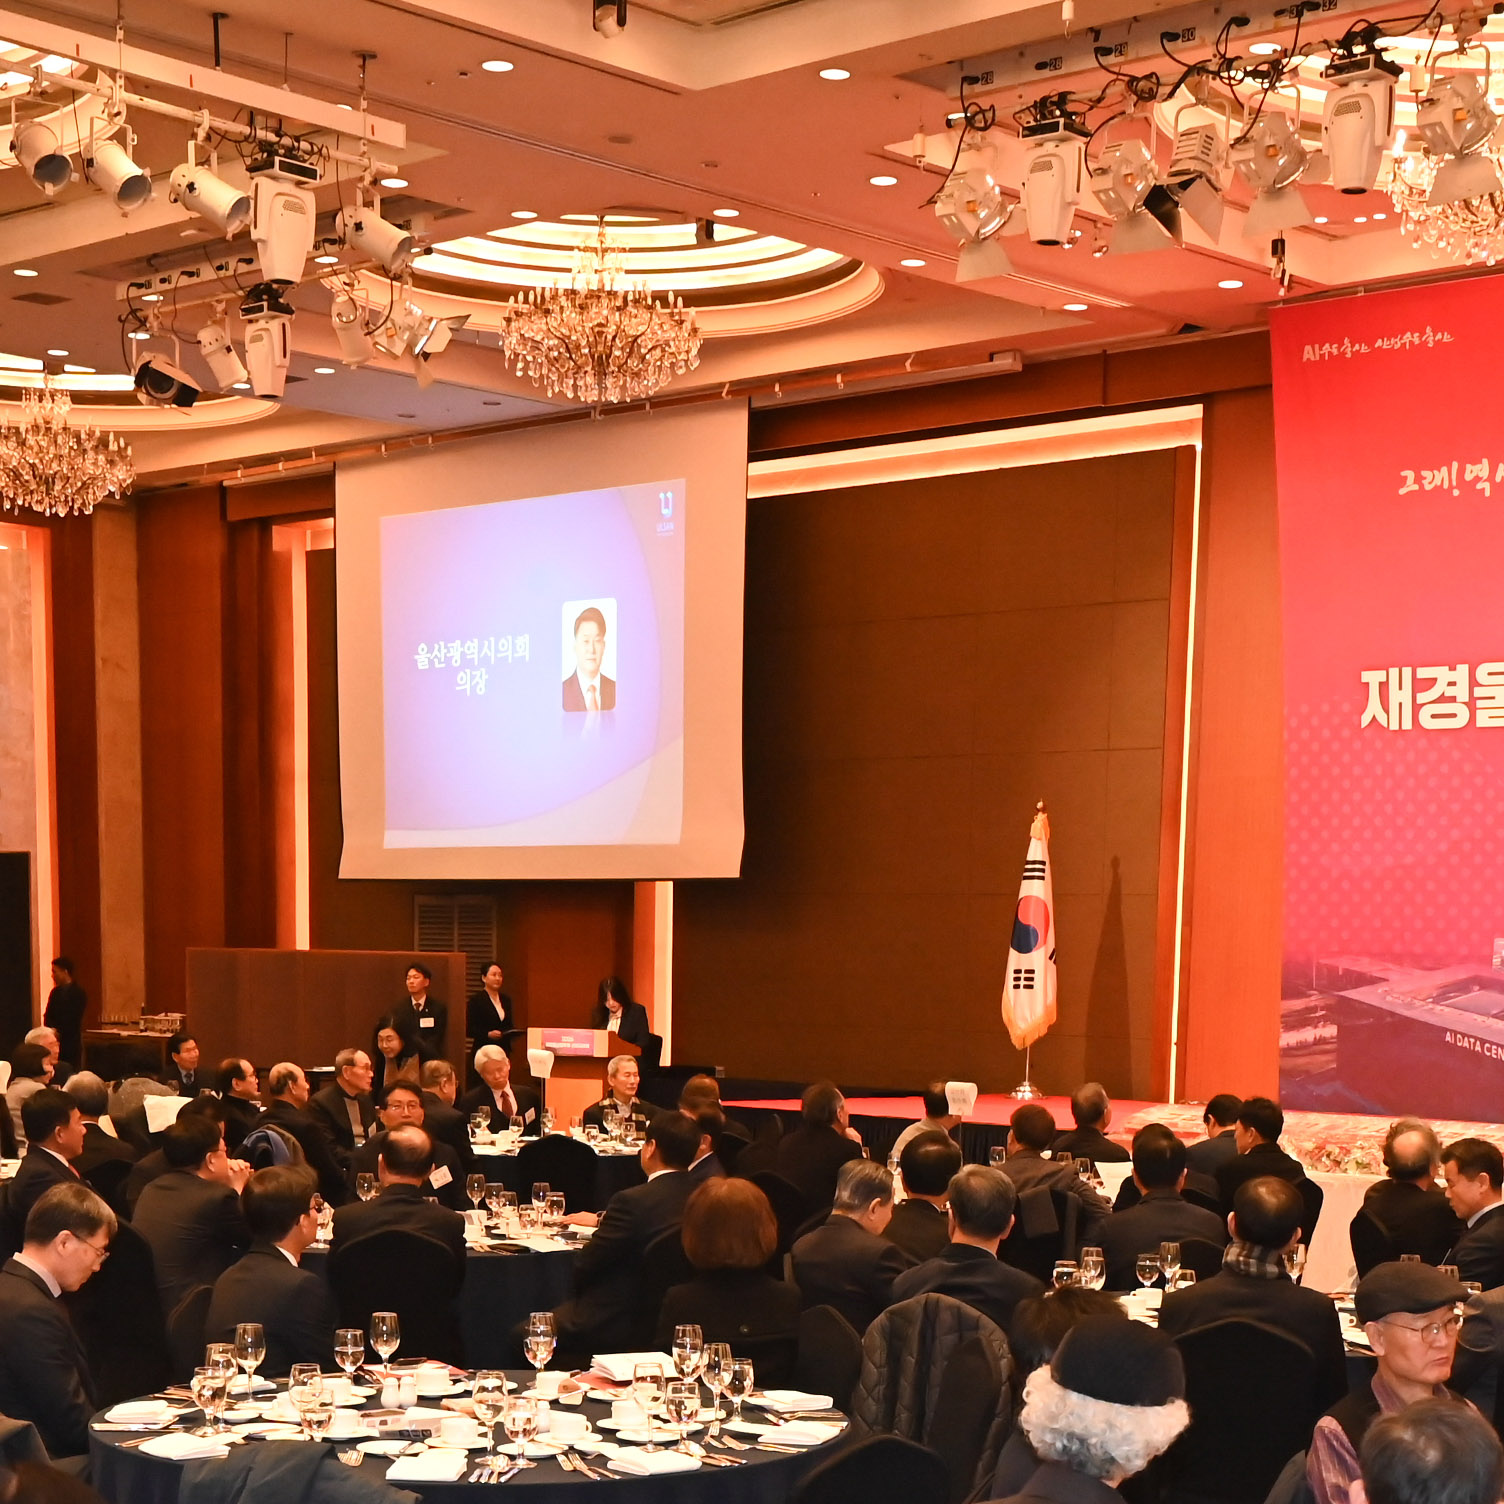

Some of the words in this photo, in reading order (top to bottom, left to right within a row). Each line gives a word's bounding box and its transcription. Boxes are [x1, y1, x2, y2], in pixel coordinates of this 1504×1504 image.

[1182, 28, 1196, 42] 30
[413, 633, 532, 671] 울산광역시의회
[454, 668, 489, 697] 의장
[1444, 1030, 1455, 1044] AI
[1456, 1033, 1482, 1053] DATA
